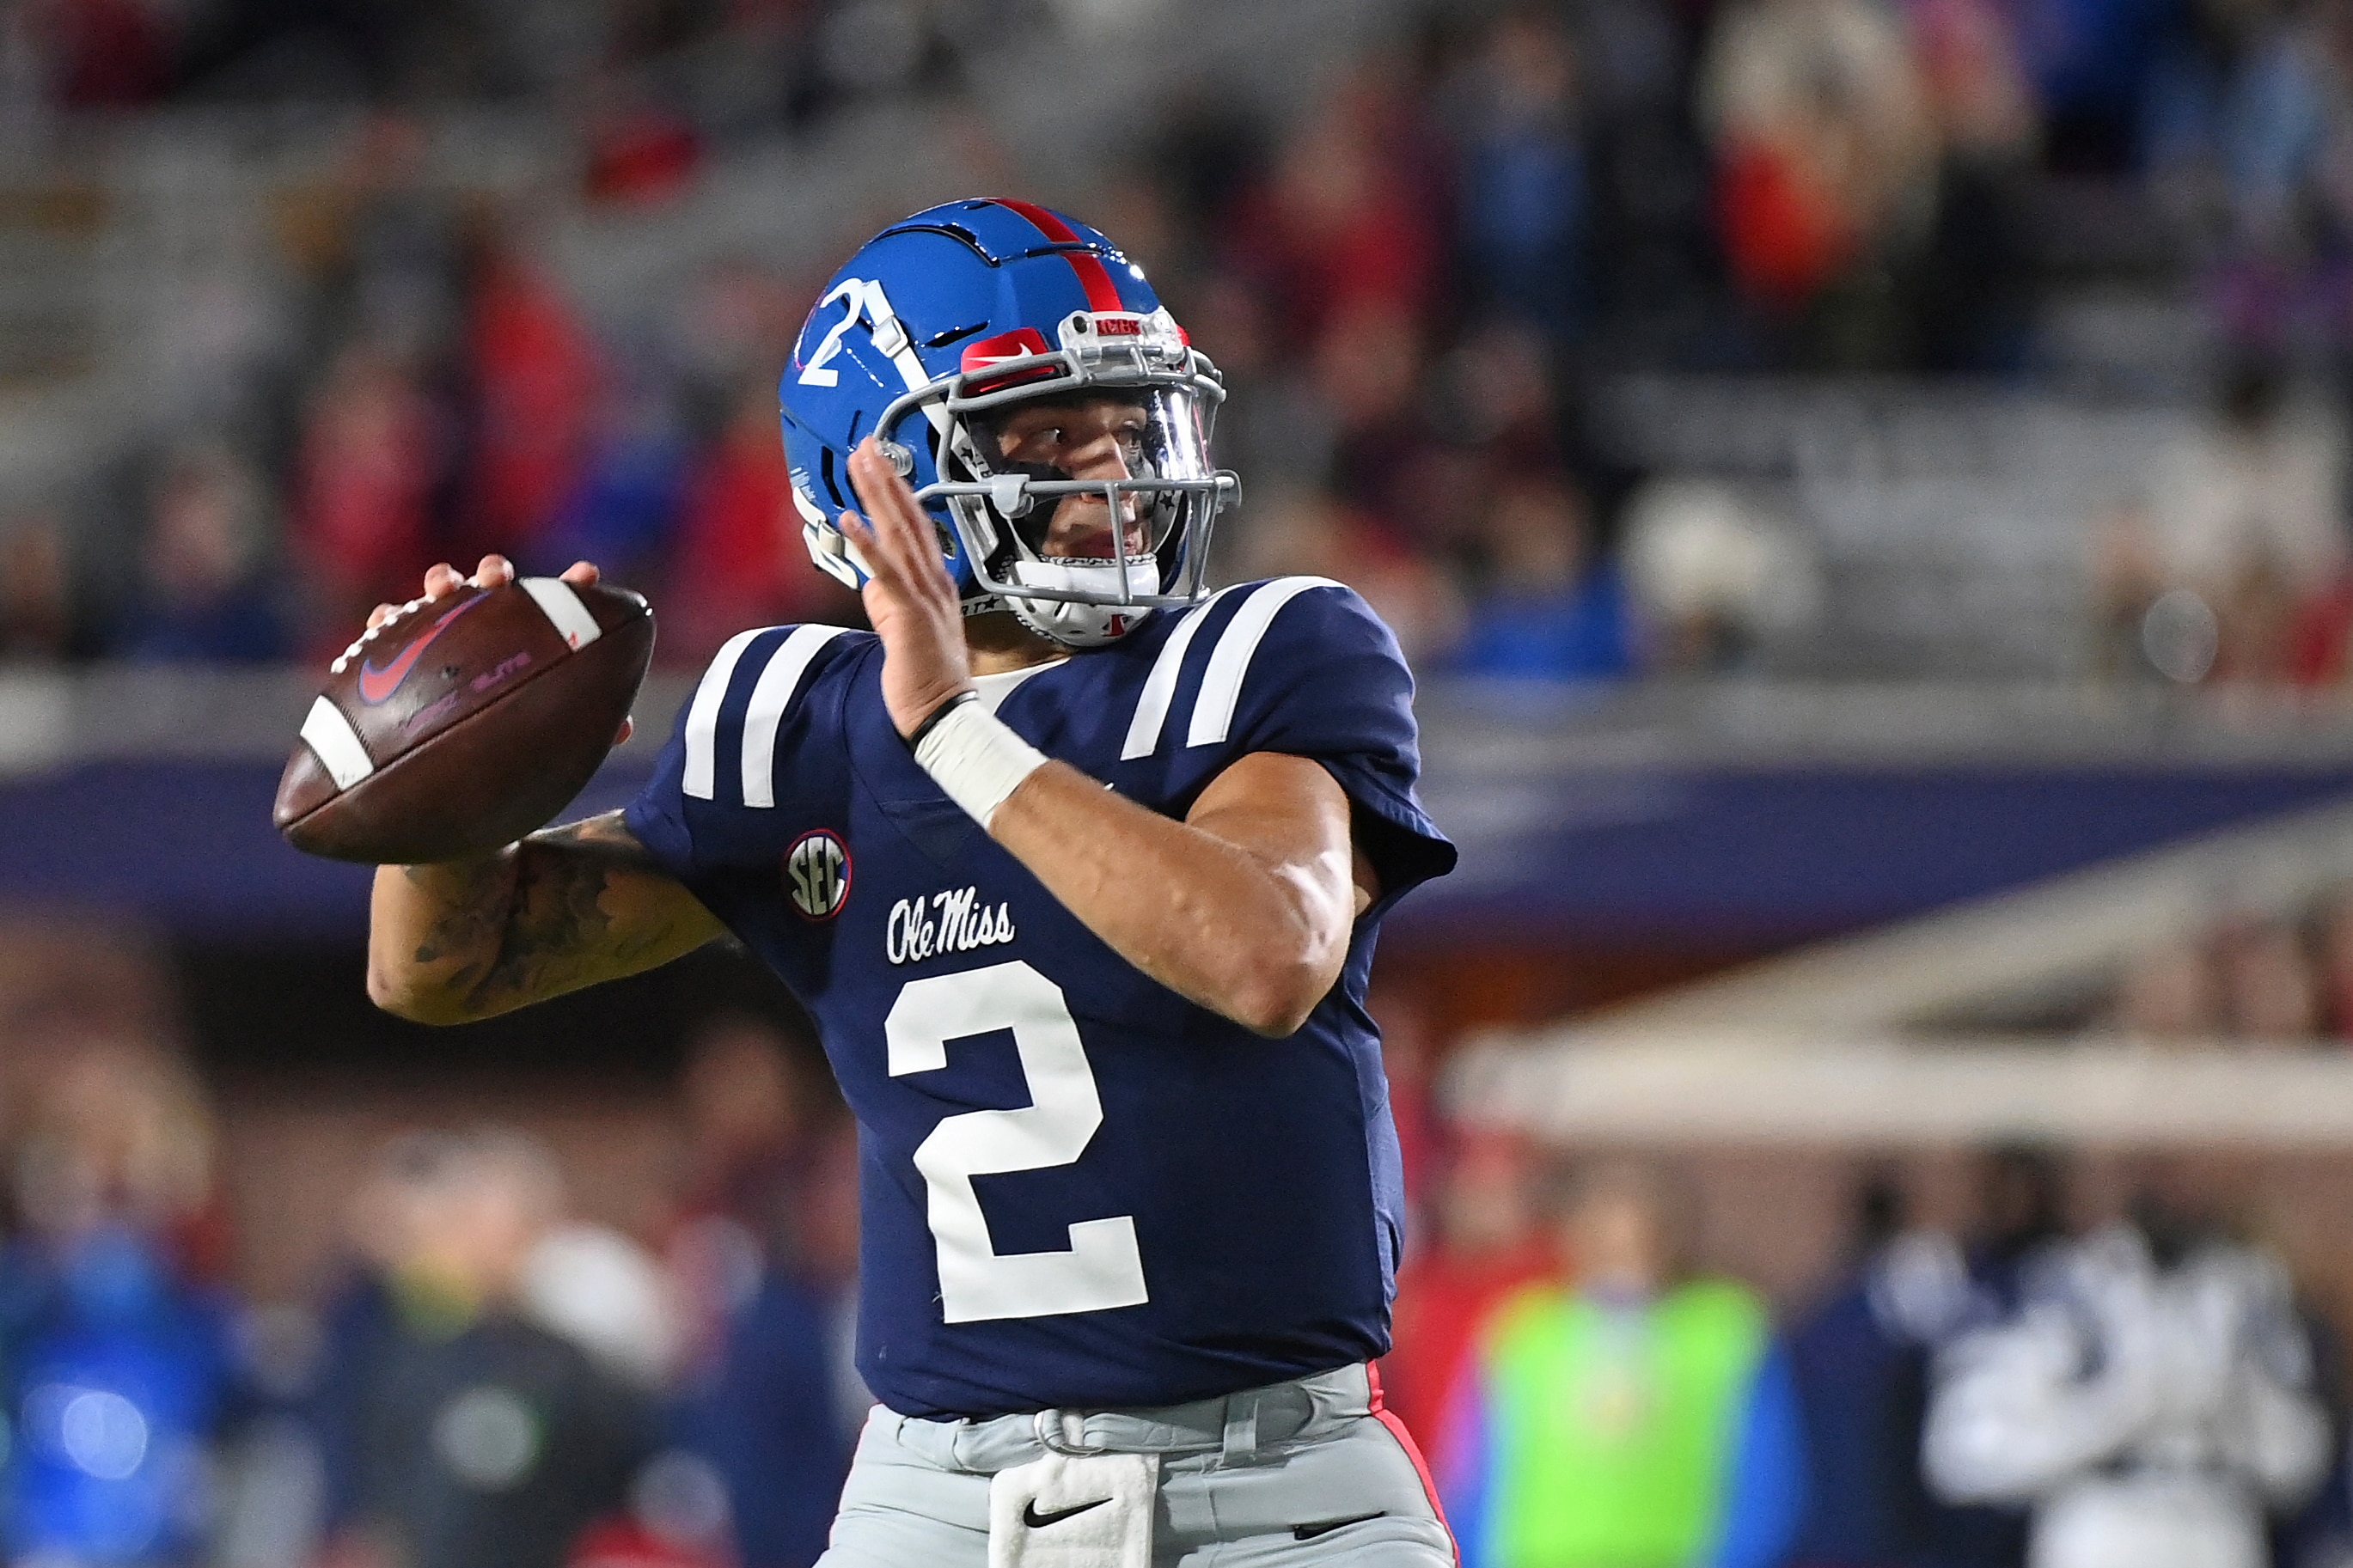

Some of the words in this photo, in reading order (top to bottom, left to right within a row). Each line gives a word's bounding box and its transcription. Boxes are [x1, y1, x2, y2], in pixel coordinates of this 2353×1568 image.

[798, 277, 863, 387] 2
[788, 836, 846, 915] SEC
[887, 895, 935, 964] Ole
[933, 886, 1016, 954] Miss
[884, 960, 1148, 1323] 2
